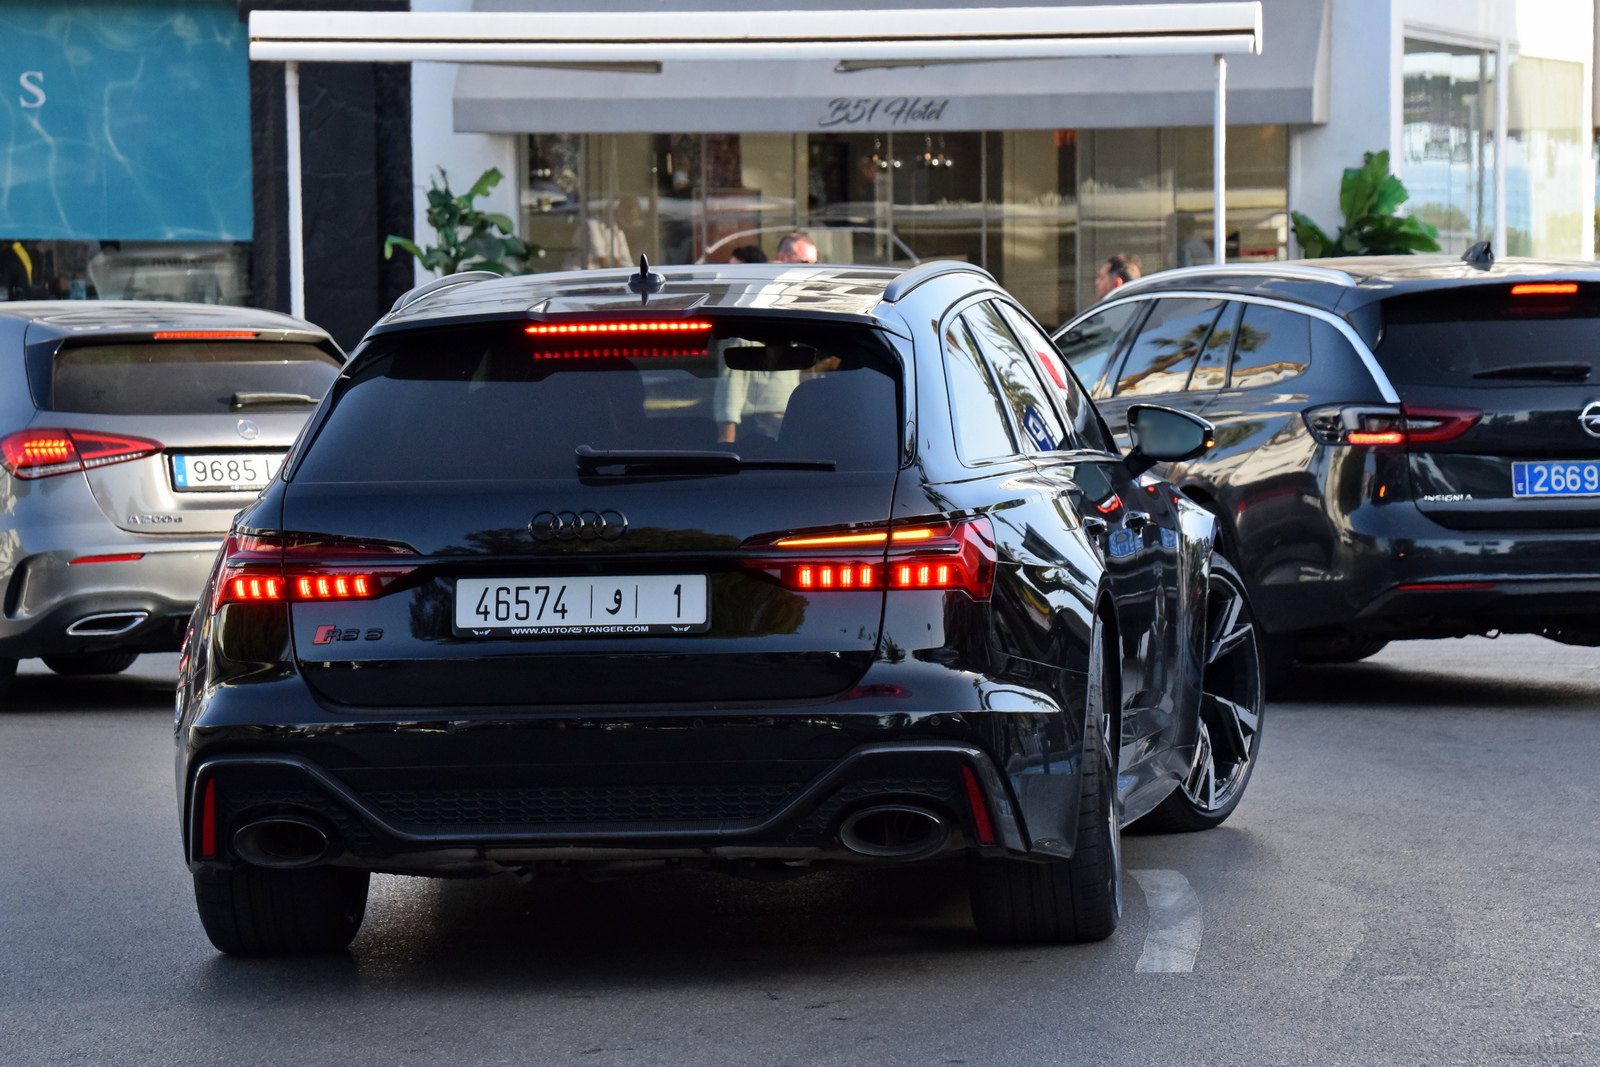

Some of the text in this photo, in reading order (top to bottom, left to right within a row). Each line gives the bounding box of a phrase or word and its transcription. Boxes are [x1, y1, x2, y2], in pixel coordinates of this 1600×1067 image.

[20, 71, 46, 108] S
[819, 97, 949, 127] B51 Hotel
[194, 460, 256, 482] 9685
[1533, 465, 1599, 492] 2669
[1424, 494, 1473, 502] INSIGNIA
[1517, 482, 1525, 491] E
[475, 585, 567, 621] 46574
[673, 584, 681, 618] 1
[321, 627, 360, 642] RS
